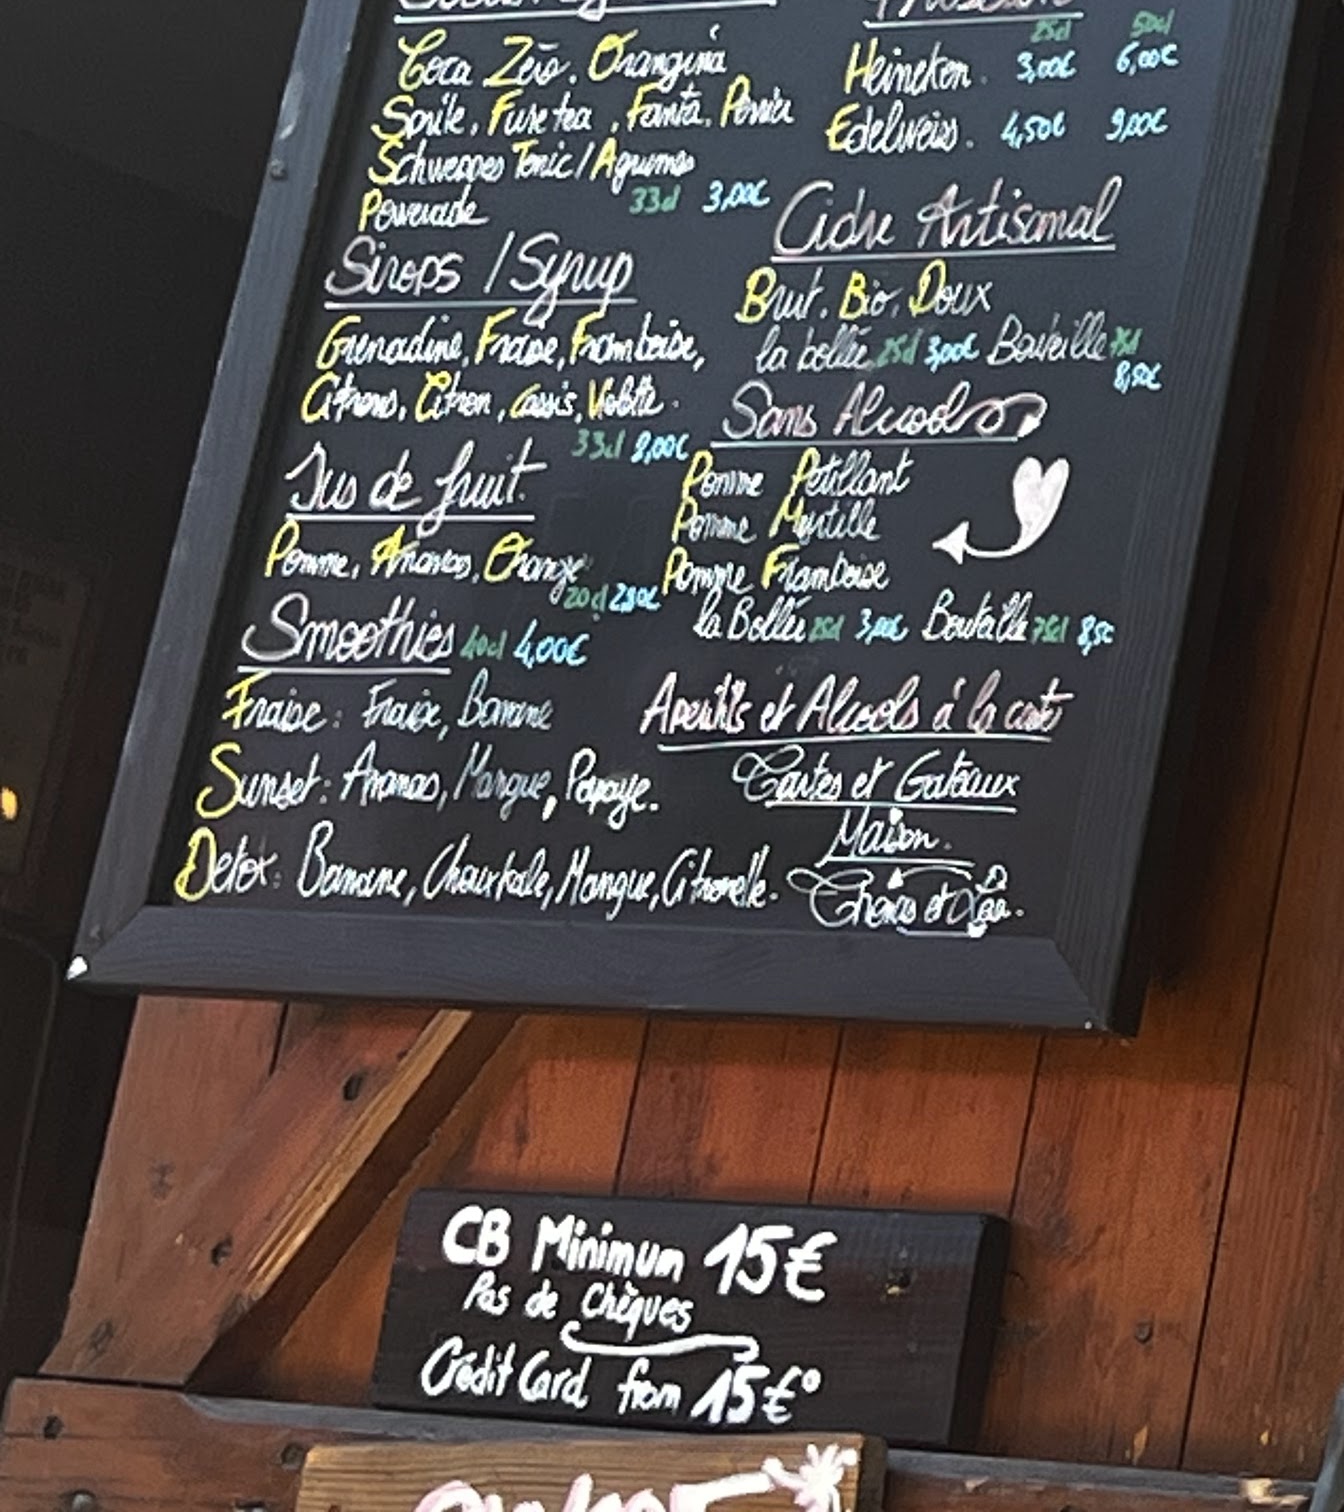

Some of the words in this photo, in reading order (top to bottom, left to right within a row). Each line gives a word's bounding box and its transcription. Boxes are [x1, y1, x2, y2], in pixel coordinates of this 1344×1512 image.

[442, 1205, 513, 1268] CB
[531, 1214, 687, 1283] Minimum
[703, 1224, 838, 1303] 15€
[462, 1271, 511, 1317] Pas
[524, 1279, 559, 1322] de
[517, 1354, 594, 1409] Card
[617, 1361, 683, 1417] from
